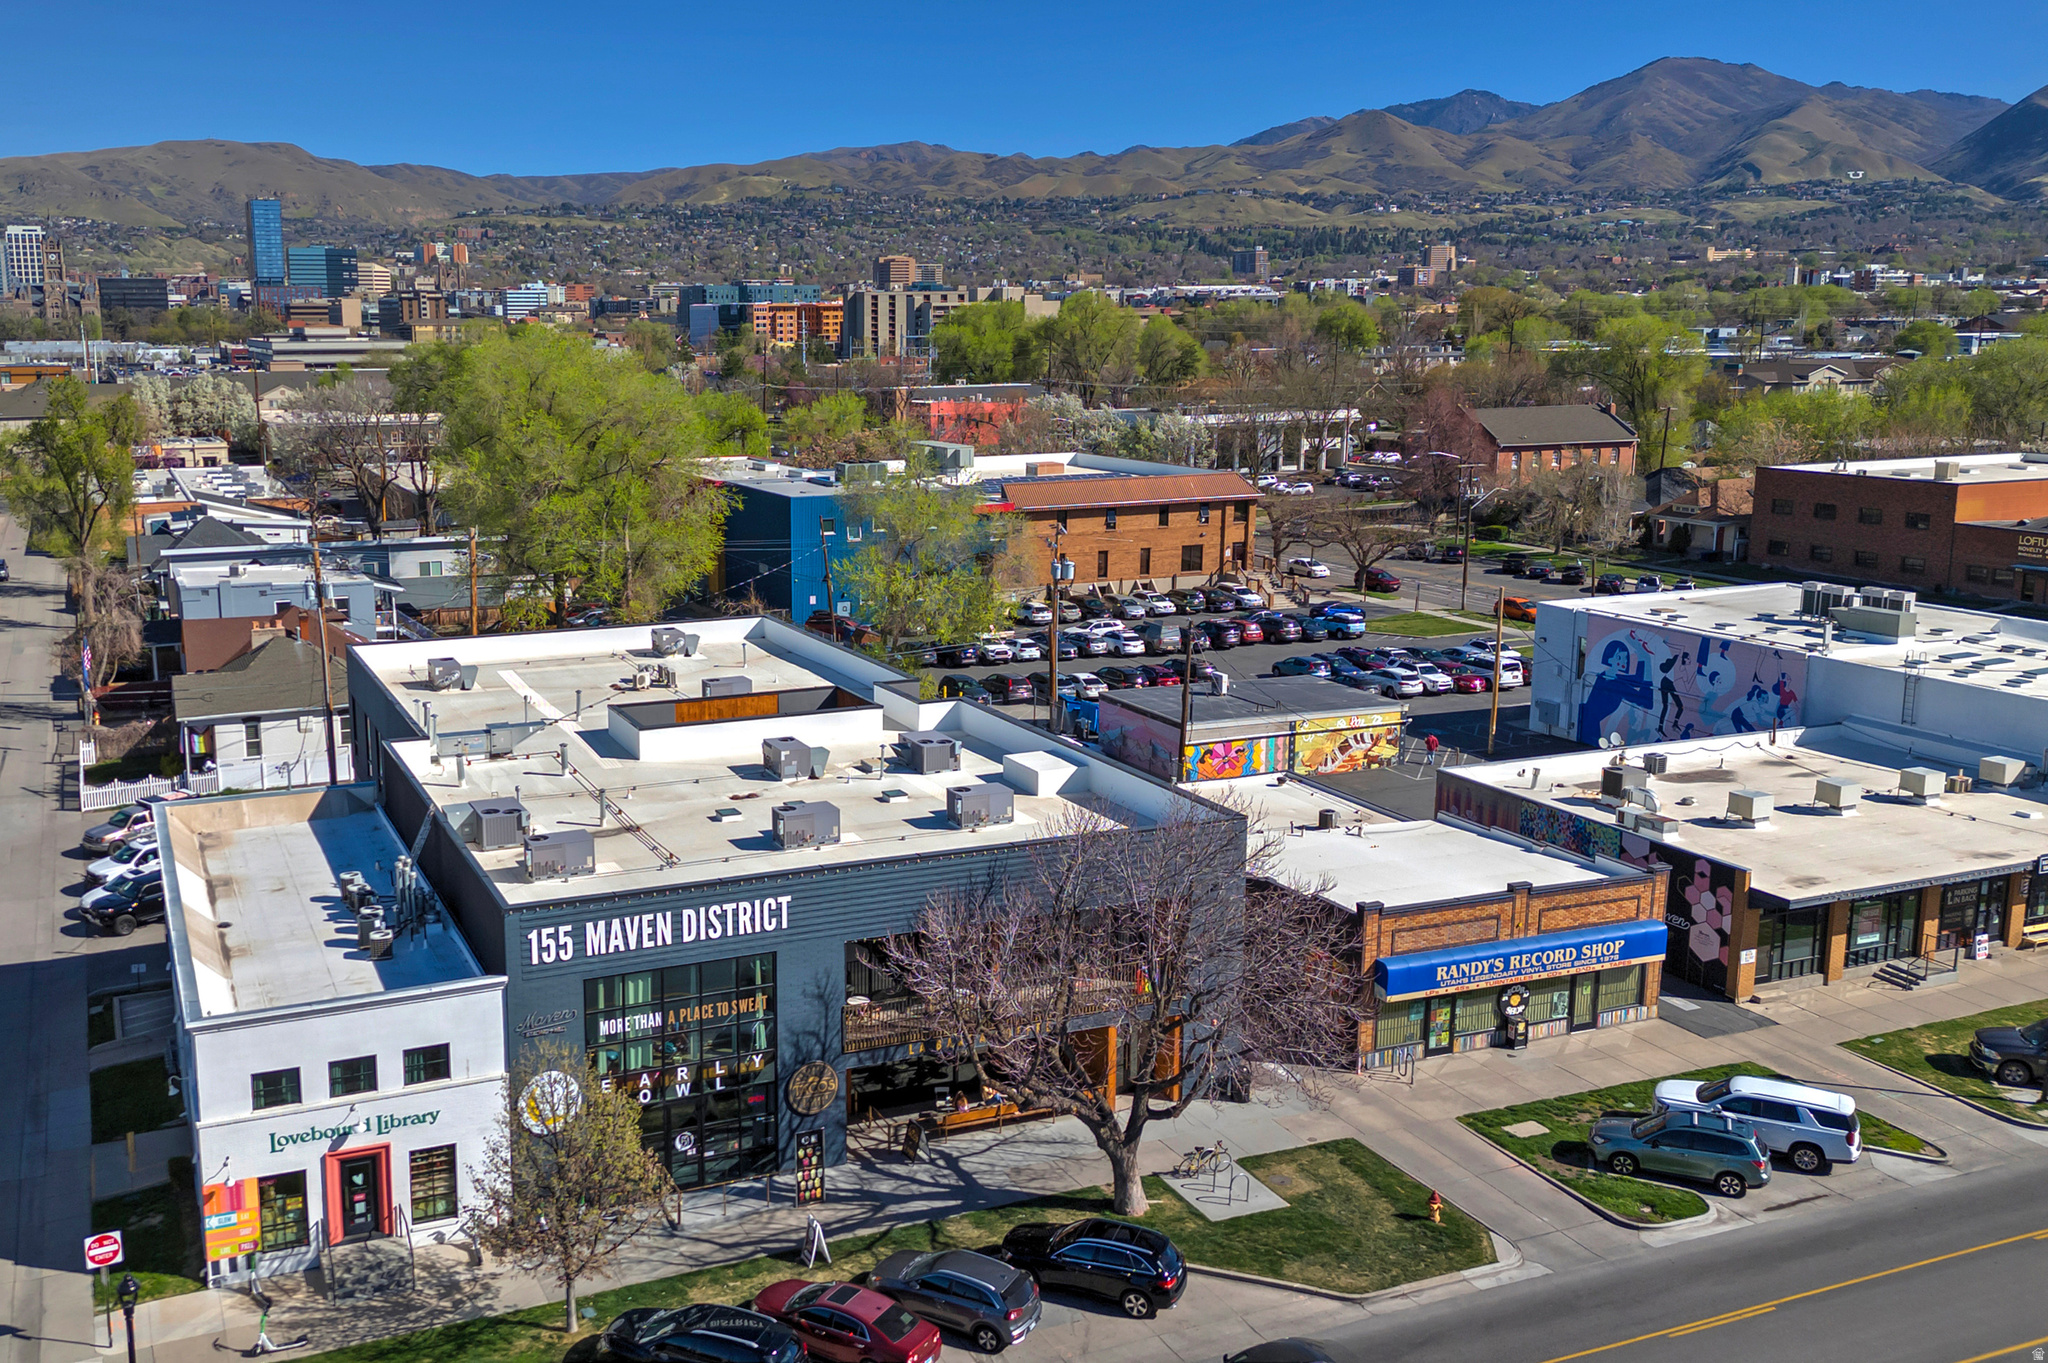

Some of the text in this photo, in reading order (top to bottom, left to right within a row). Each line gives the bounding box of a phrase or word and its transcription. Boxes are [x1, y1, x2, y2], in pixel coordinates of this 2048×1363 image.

[1954, 886, 1978, 896] PARKING
[1954, 894, 1977, 904] IN BACK
[527, 895, 792, 966] 155 MAVEN DISTRICT
[1436, 940, 1625, 981] RANDY'S RECORD SHOP
[1440, 977, 1469, 987] UTAH'S
[1471, 969, 1518, 982] LEGENDARY
[1521, 965, 1544, 975] VINYL
[1546, 962, 1572, 971] STORE
[1574, 958, 1597, 967] SINCE
[1484, 975, 1534, 987] TURNTABLES
[1609, 960, 1632, 968] TAPES
[599, 995, 768, 1037] MORE THAN A PLACE TO SWEAT
[639, 1077, 726, 1104] OWL
[792, 1079, 837, 1097] TACOS
[376, 1110, 441, 1136] Library
[95, 1252, 114, 1261] ENTER
